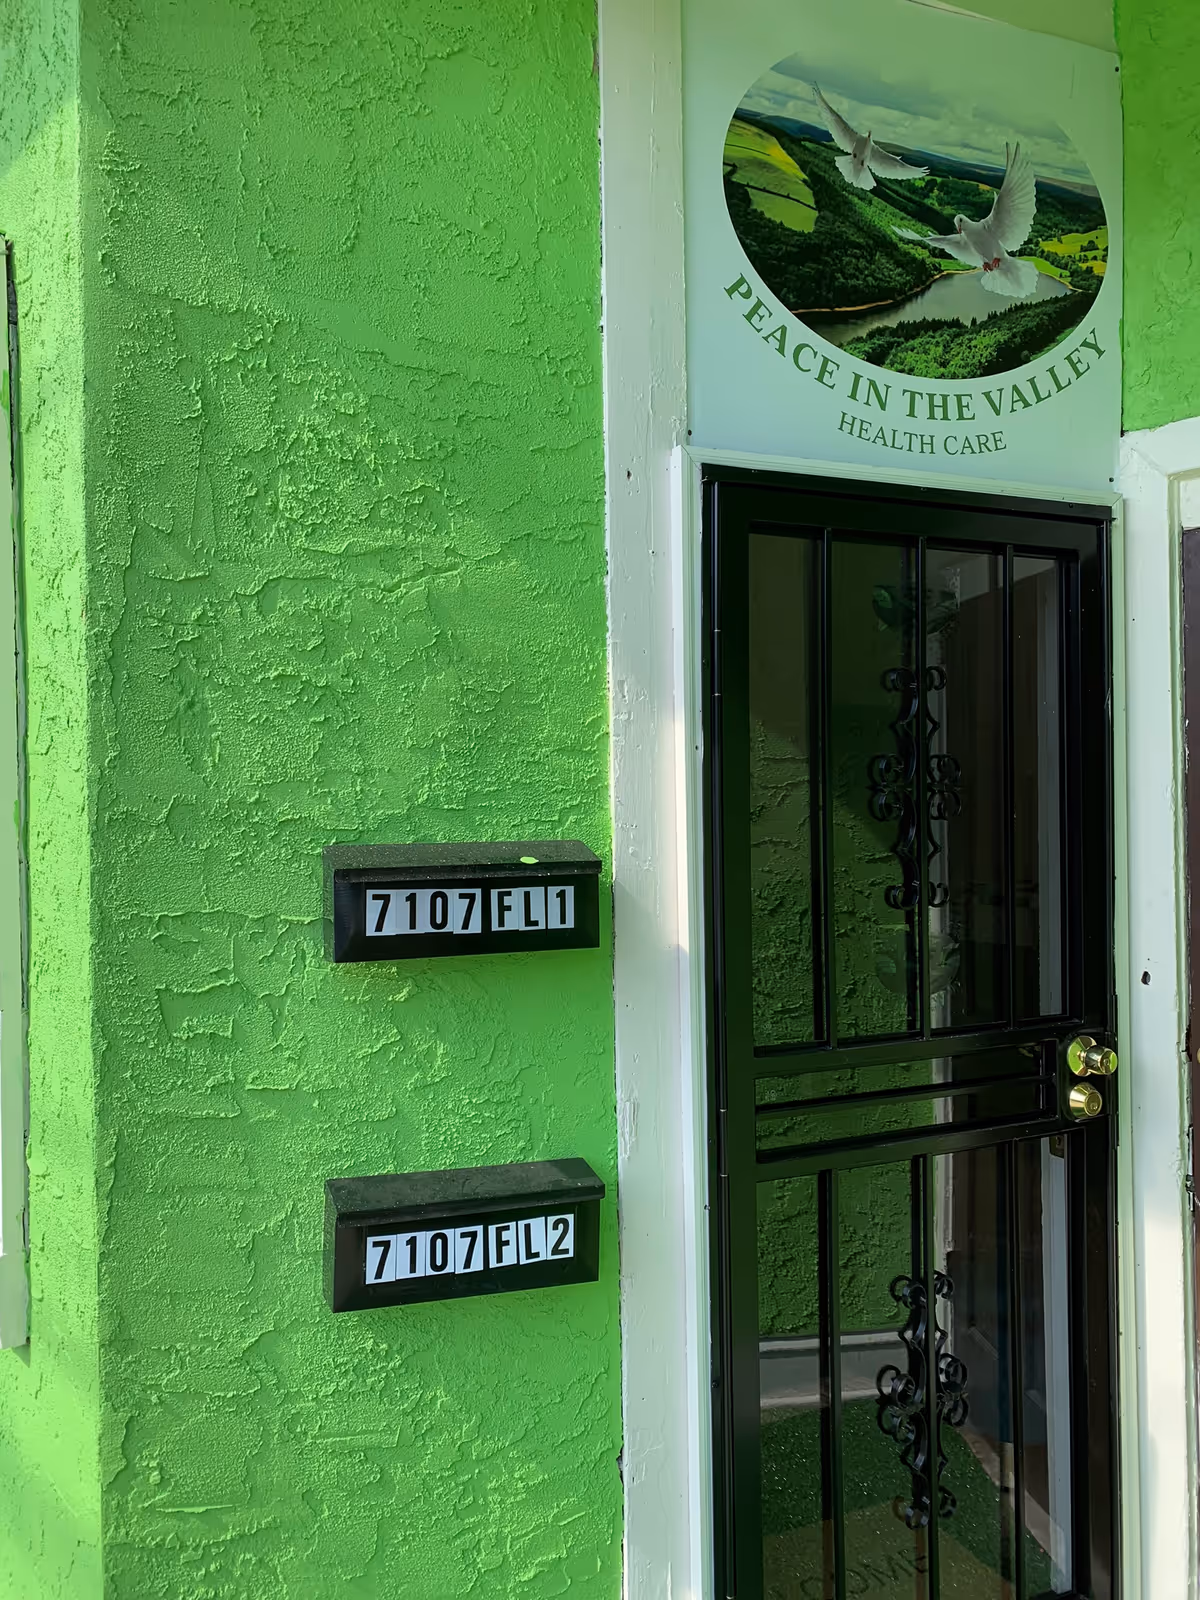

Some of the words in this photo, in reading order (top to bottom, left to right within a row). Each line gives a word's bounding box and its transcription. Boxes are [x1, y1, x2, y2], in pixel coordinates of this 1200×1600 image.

[723, 273, 840, 389] PEACE
[847, 371, 892, 411] IN
[902, 389, 976, 421] THE
[981, 328, 1107, 416] VALLEY
[837, 411, 936, 455] HEALTH
[943, 431, 1007, 456] CARE
[371, 890, 477, 933] 7107
[372, 1230, 478, 1280] 7107
